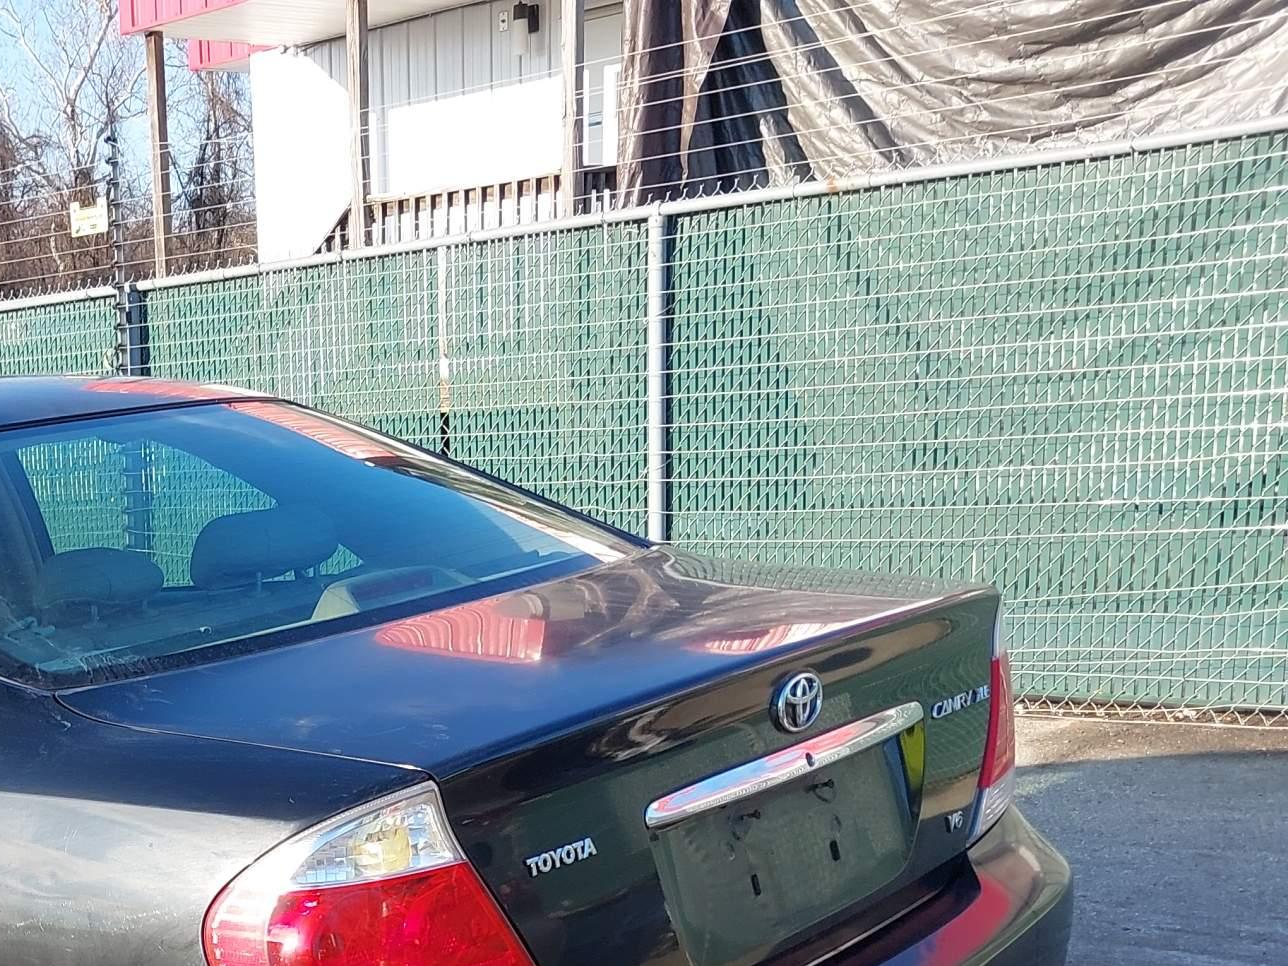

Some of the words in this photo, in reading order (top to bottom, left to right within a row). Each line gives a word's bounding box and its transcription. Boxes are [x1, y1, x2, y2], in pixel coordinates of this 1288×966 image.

[932, 689, 974, 719] CAMRY
[945, 810, 963, 833] V6
[525, 837, 598, 877] TOYOTA
